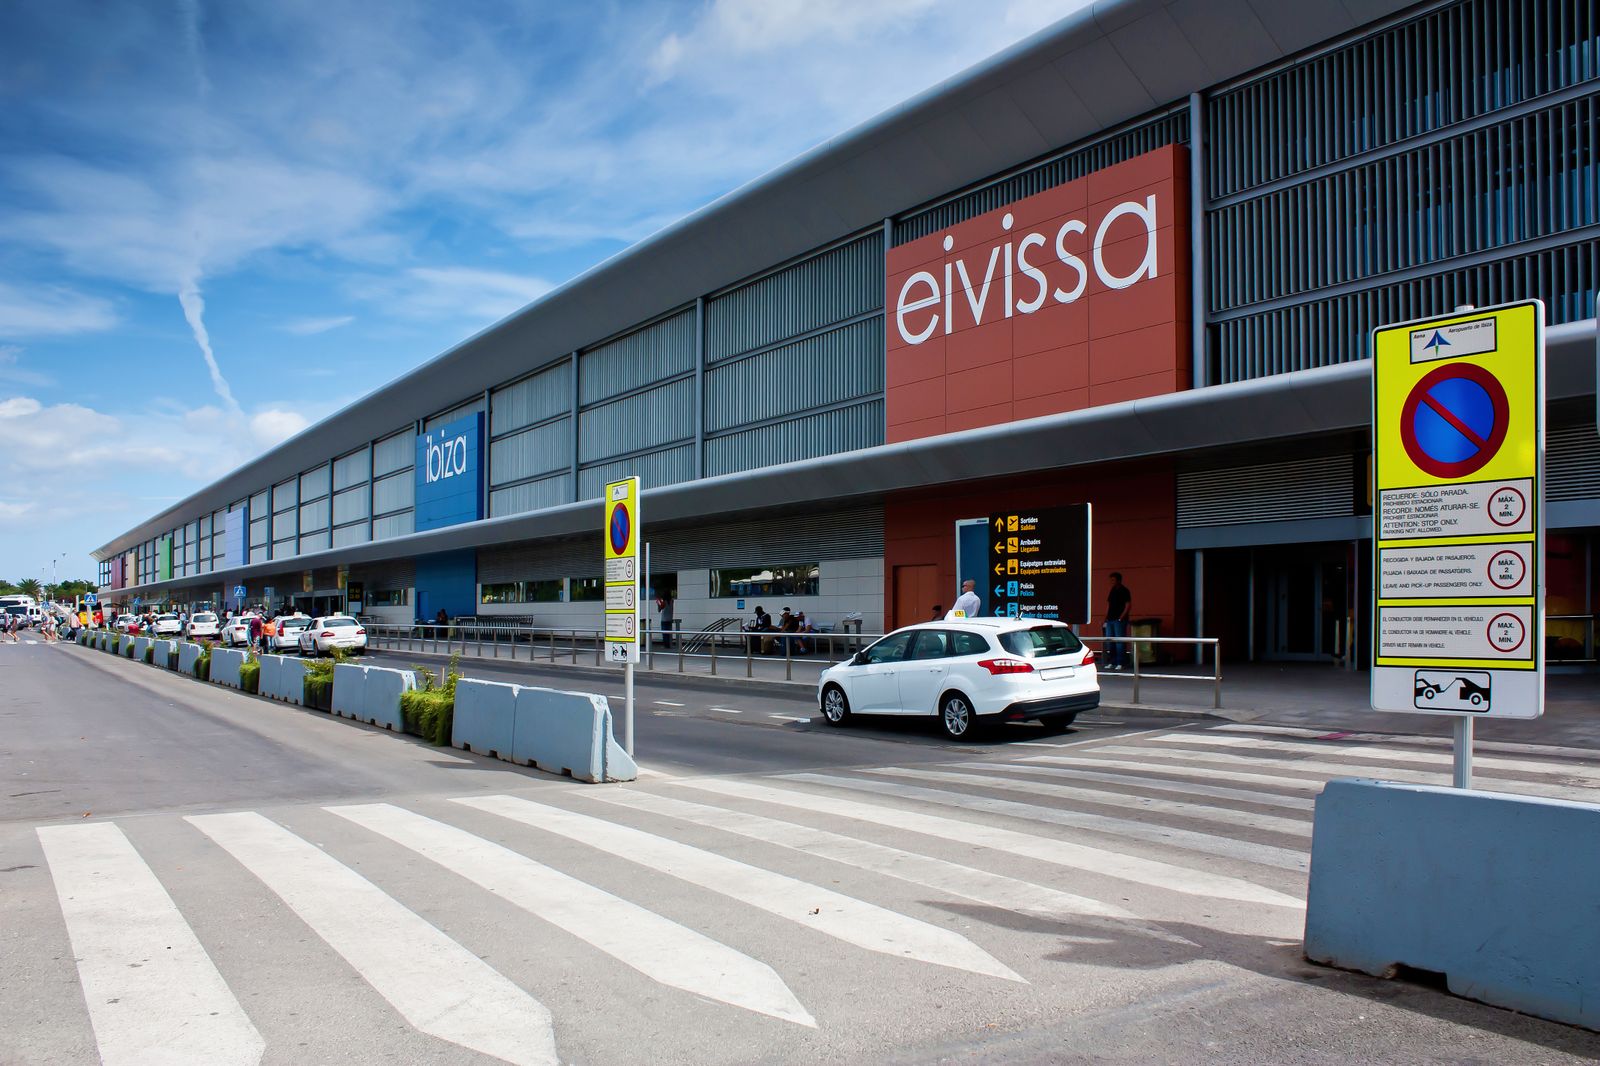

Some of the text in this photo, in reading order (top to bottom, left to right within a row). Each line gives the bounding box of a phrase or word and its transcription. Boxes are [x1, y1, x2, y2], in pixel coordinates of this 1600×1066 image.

[896, 194, 1157, 345] eivissa
[426, 430, 466, 483] ibiza
[1440, 503, 1480, 511] ATURAR-SE.
